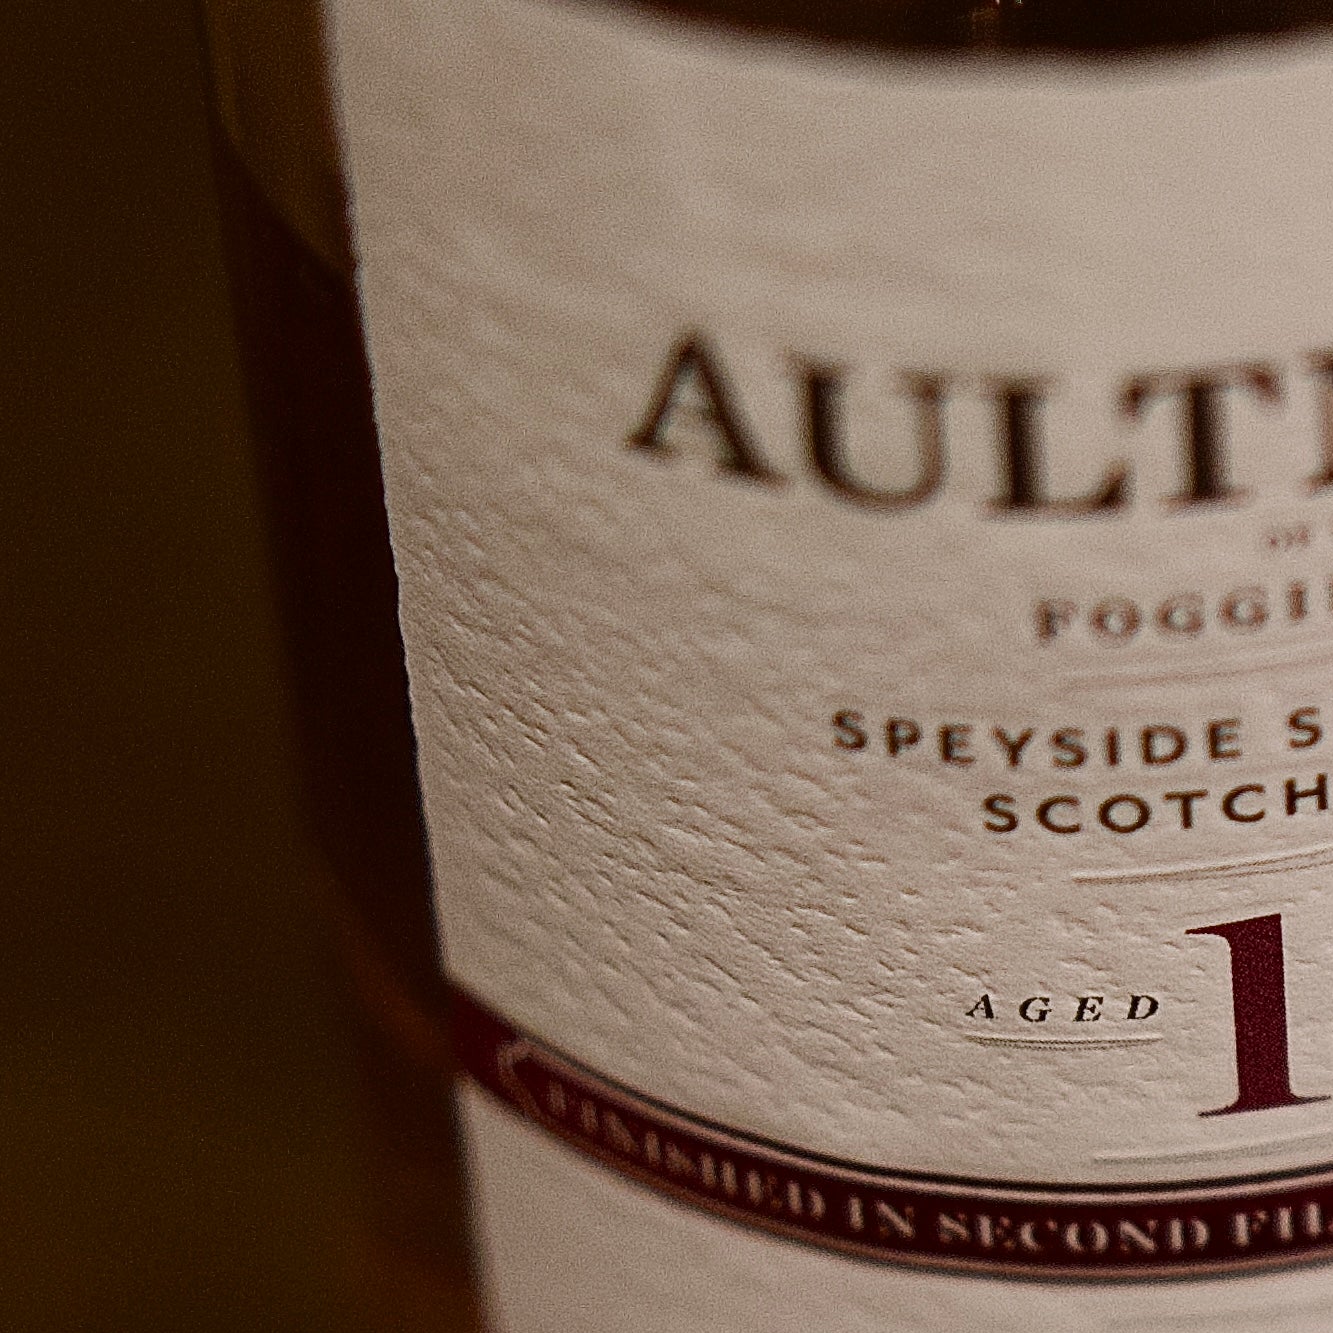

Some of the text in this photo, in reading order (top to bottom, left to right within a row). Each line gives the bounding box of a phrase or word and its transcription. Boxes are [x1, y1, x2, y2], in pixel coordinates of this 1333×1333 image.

[831, 709, 1243, 770] SPEYSIDE
[984, 773, 1330, 834] SCOTCH
[965, 993, 1161, 1024] AGED
[547, 1080, 826, 1221] FINISHED
[848, 1194, 916, 1239] IN
[937, 1210, 1210, 1253] SECOND
